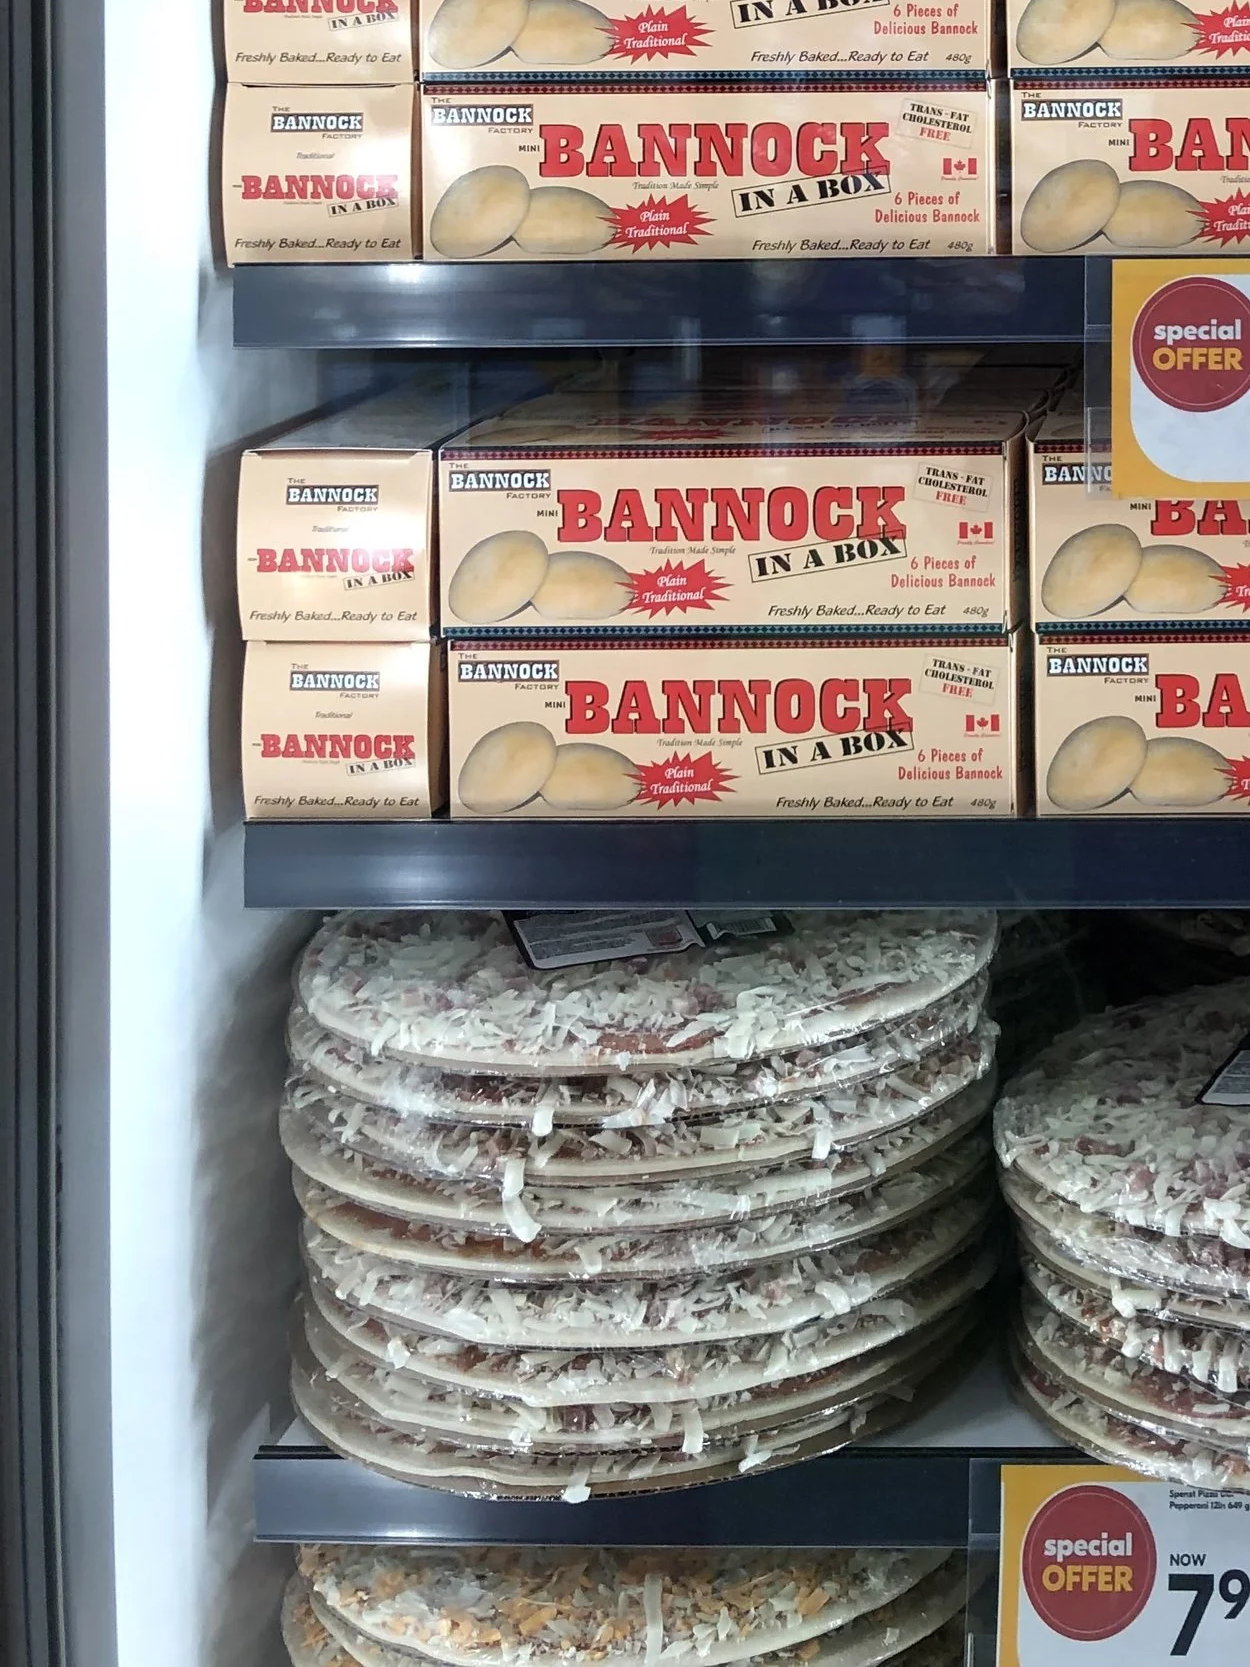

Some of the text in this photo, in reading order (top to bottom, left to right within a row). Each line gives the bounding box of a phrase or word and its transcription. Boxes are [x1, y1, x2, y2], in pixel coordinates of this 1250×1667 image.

[751, 50, 795, 64] Freshly
[889, 52, 903, 62] to
[906, 51, 929, 61] Eat
[944, 53, 972, 65] 480g
[539, 122, 891, 177] BANNOCK
[241, 174, 399, 200] BANNOCK
[1153, 319, 1241, 345] special
[1152, 347, 1244, 372] OFFER
[557, 486, 907, 542] BANNOCK
[255, 547, 415, 572] BANNOCK
[754, 536, 902, 577] IN A BOX
[457, 664, 557, 681] BANNOCK
[564, 678, 914, 734] BANNOCK
[259, 733, 416, 759] BANNOCK
[1044, 1533, 1132, 1562] special
[1169, 1553, 1207, 1567] NOW
[1042, 1564, 1133, 1593] OFFER
